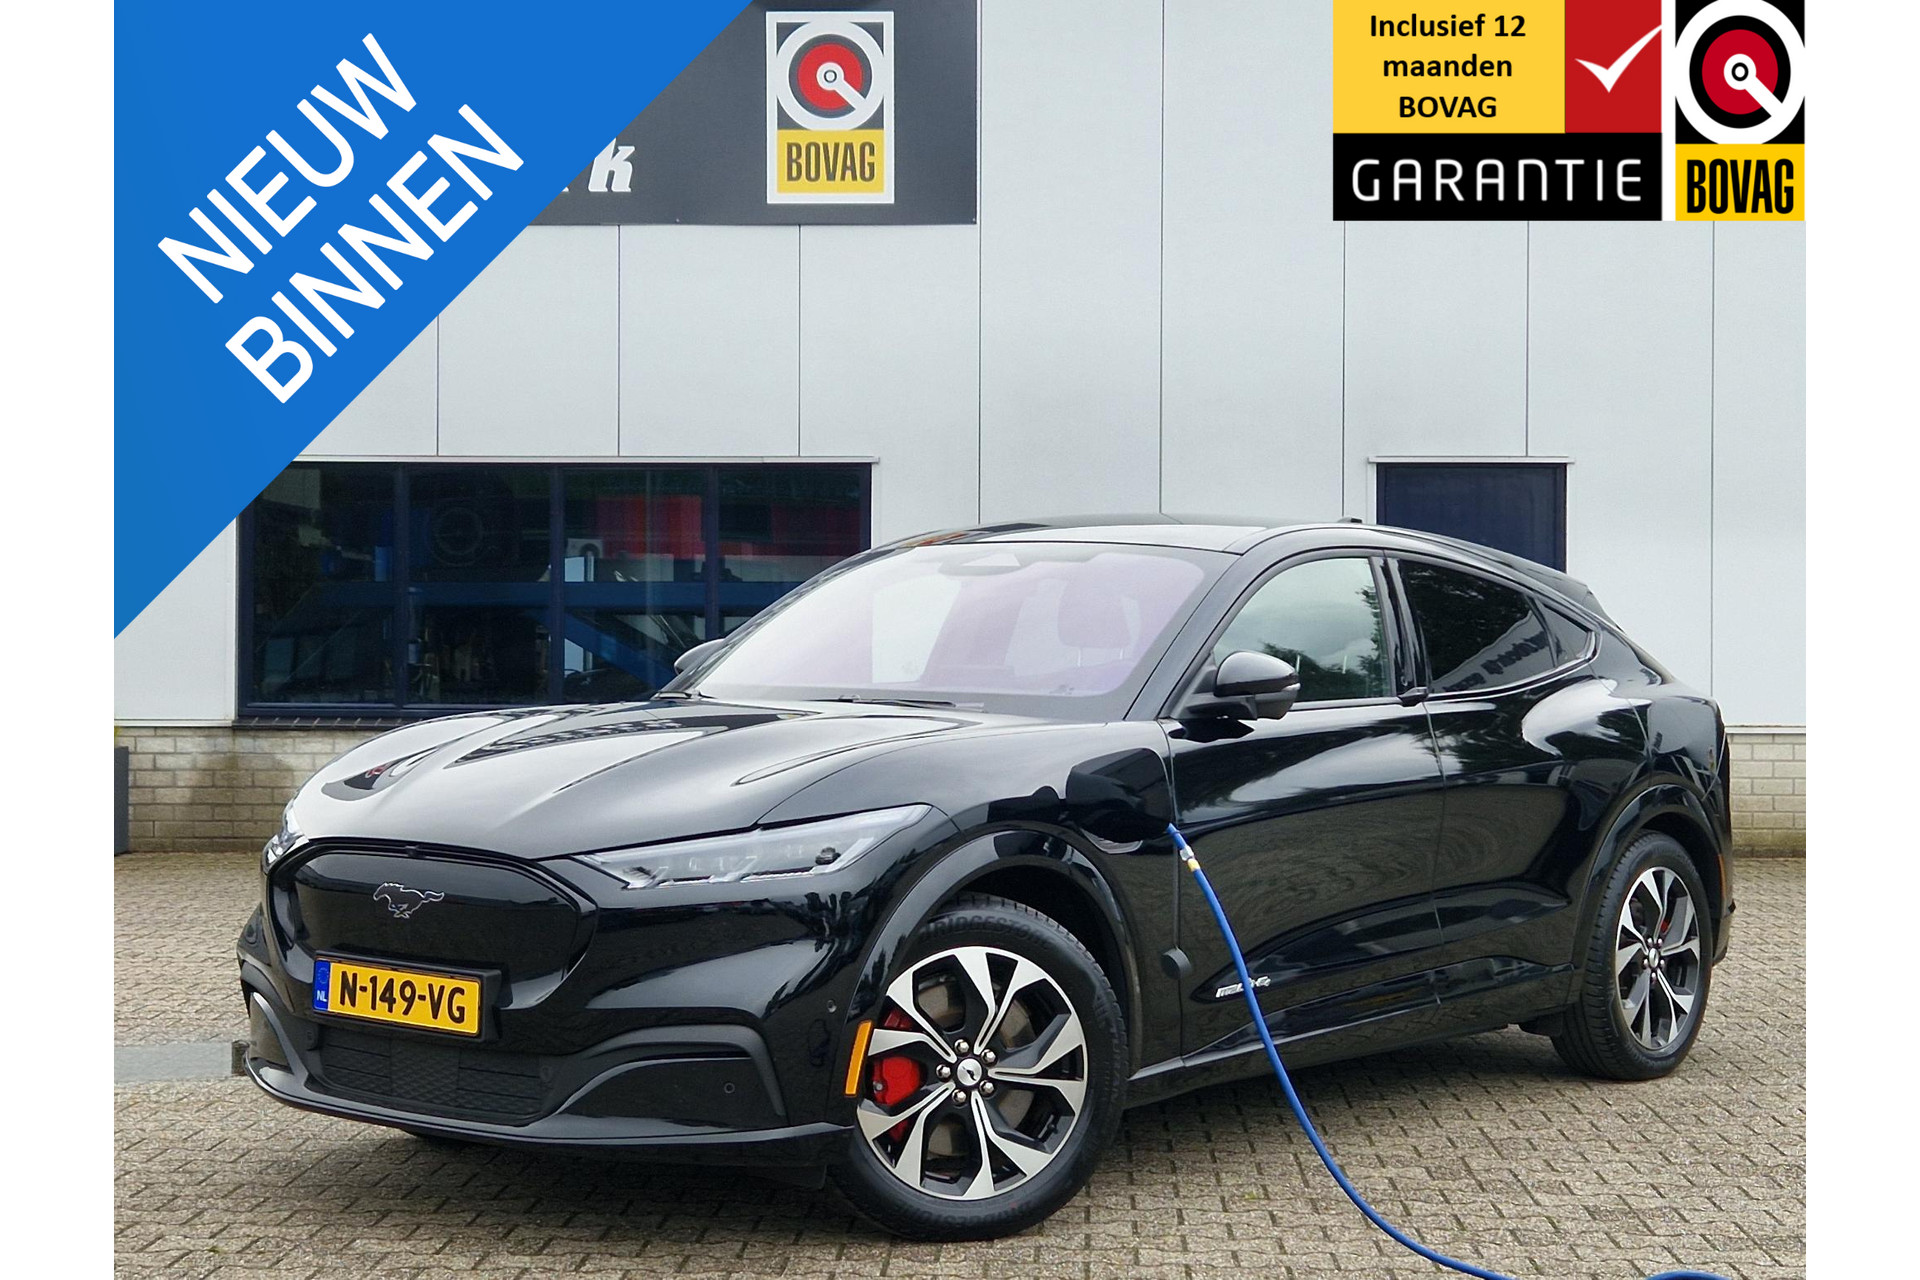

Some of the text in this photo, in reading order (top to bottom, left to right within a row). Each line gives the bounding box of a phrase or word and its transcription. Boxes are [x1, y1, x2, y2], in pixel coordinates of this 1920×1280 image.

[786, 141, 876, 183] BOVAG
[316, 990, 328, 1003] NL
[339, 970, 466, 1025] N-149-VG
